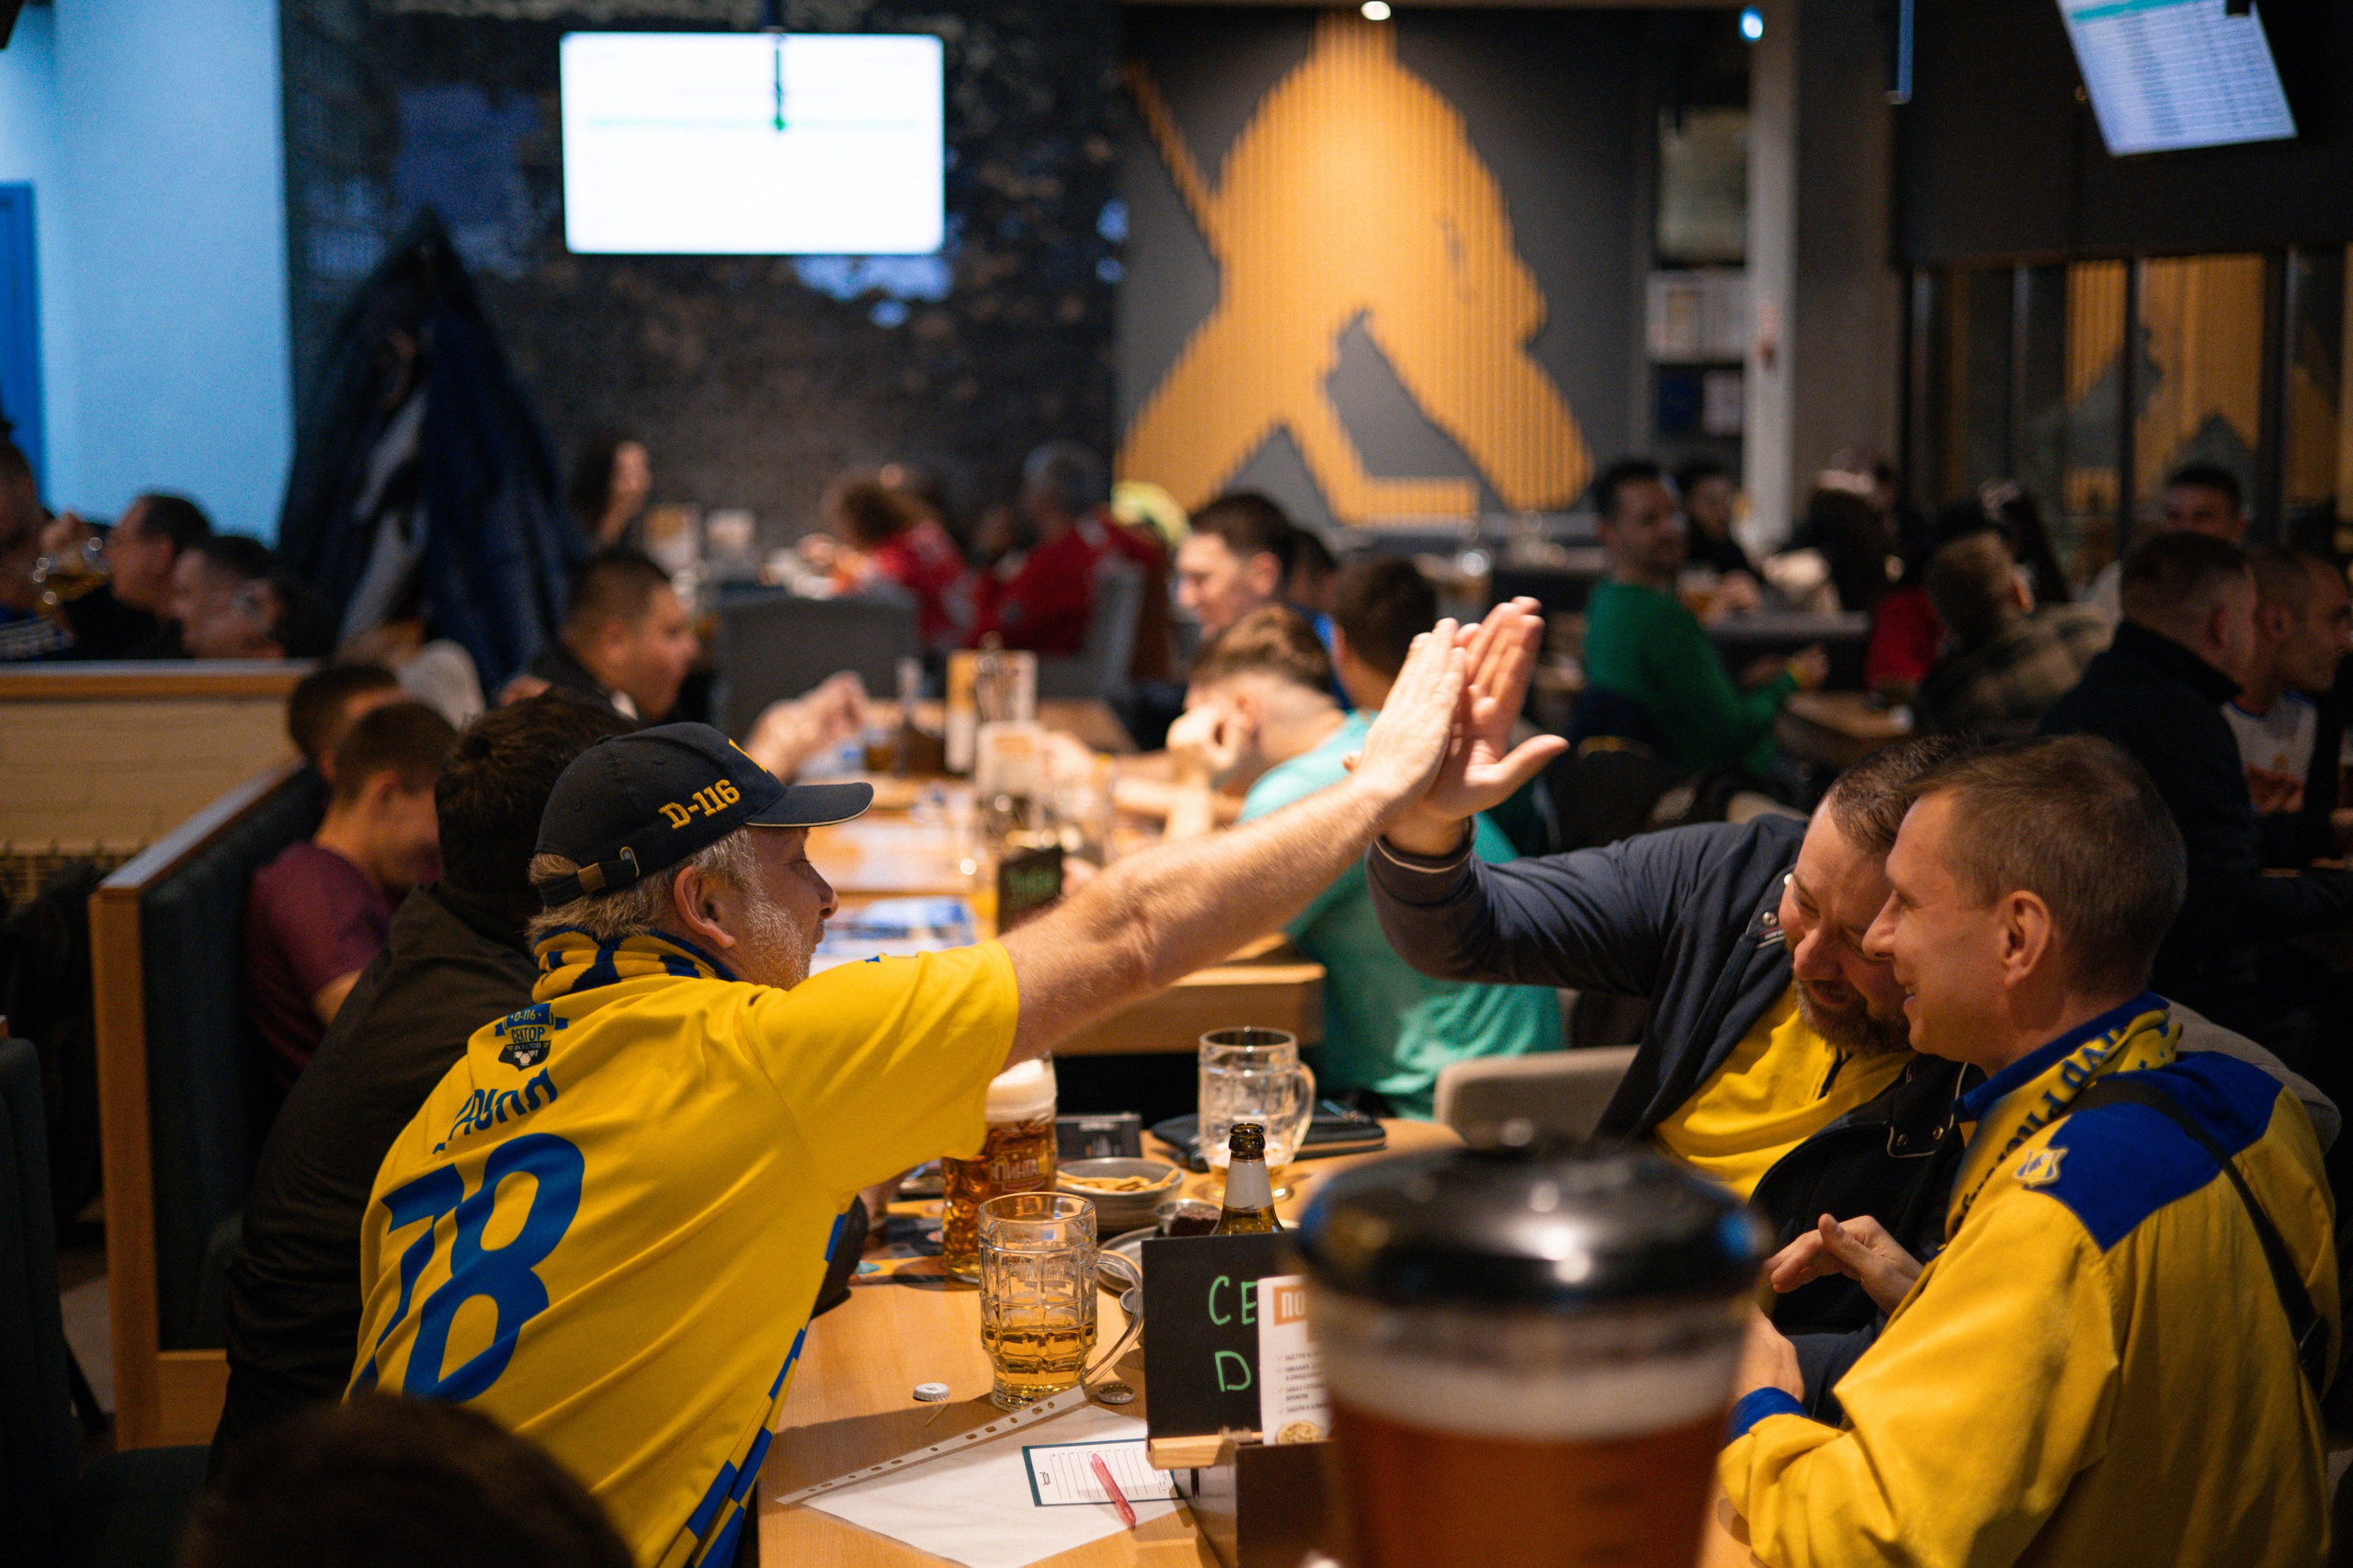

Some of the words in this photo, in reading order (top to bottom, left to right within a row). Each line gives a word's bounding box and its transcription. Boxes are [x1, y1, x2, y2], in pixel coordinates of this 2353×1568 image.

[658, 778, 740, 829] D-116
[348, 1132, 585, 1403] 78
[1215, 1350, 1251, 1392] D
